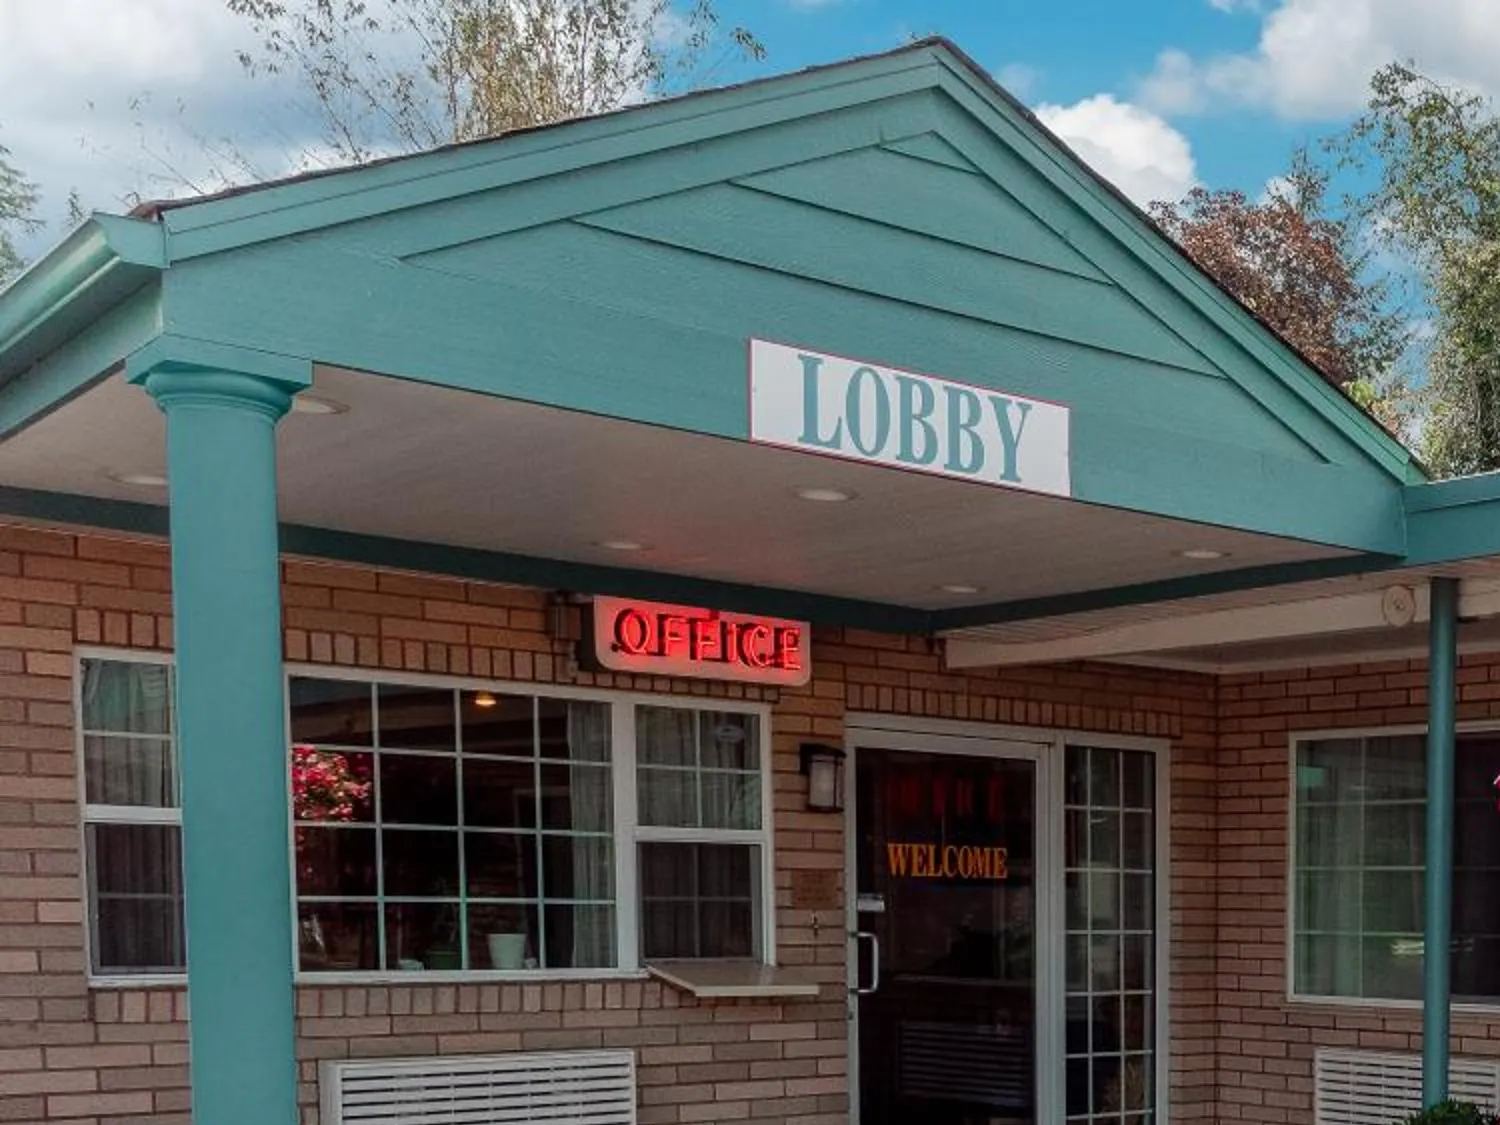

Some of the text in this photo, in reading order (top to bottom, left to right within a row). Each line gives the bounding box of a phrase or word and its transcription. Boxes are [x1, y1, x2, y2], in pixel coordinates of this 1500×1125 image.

[797, 354, 1032, 483] LOBBY
[613, 607, 802, 671] OFFICE
[887, 843, 1008, 879] WELCOME
